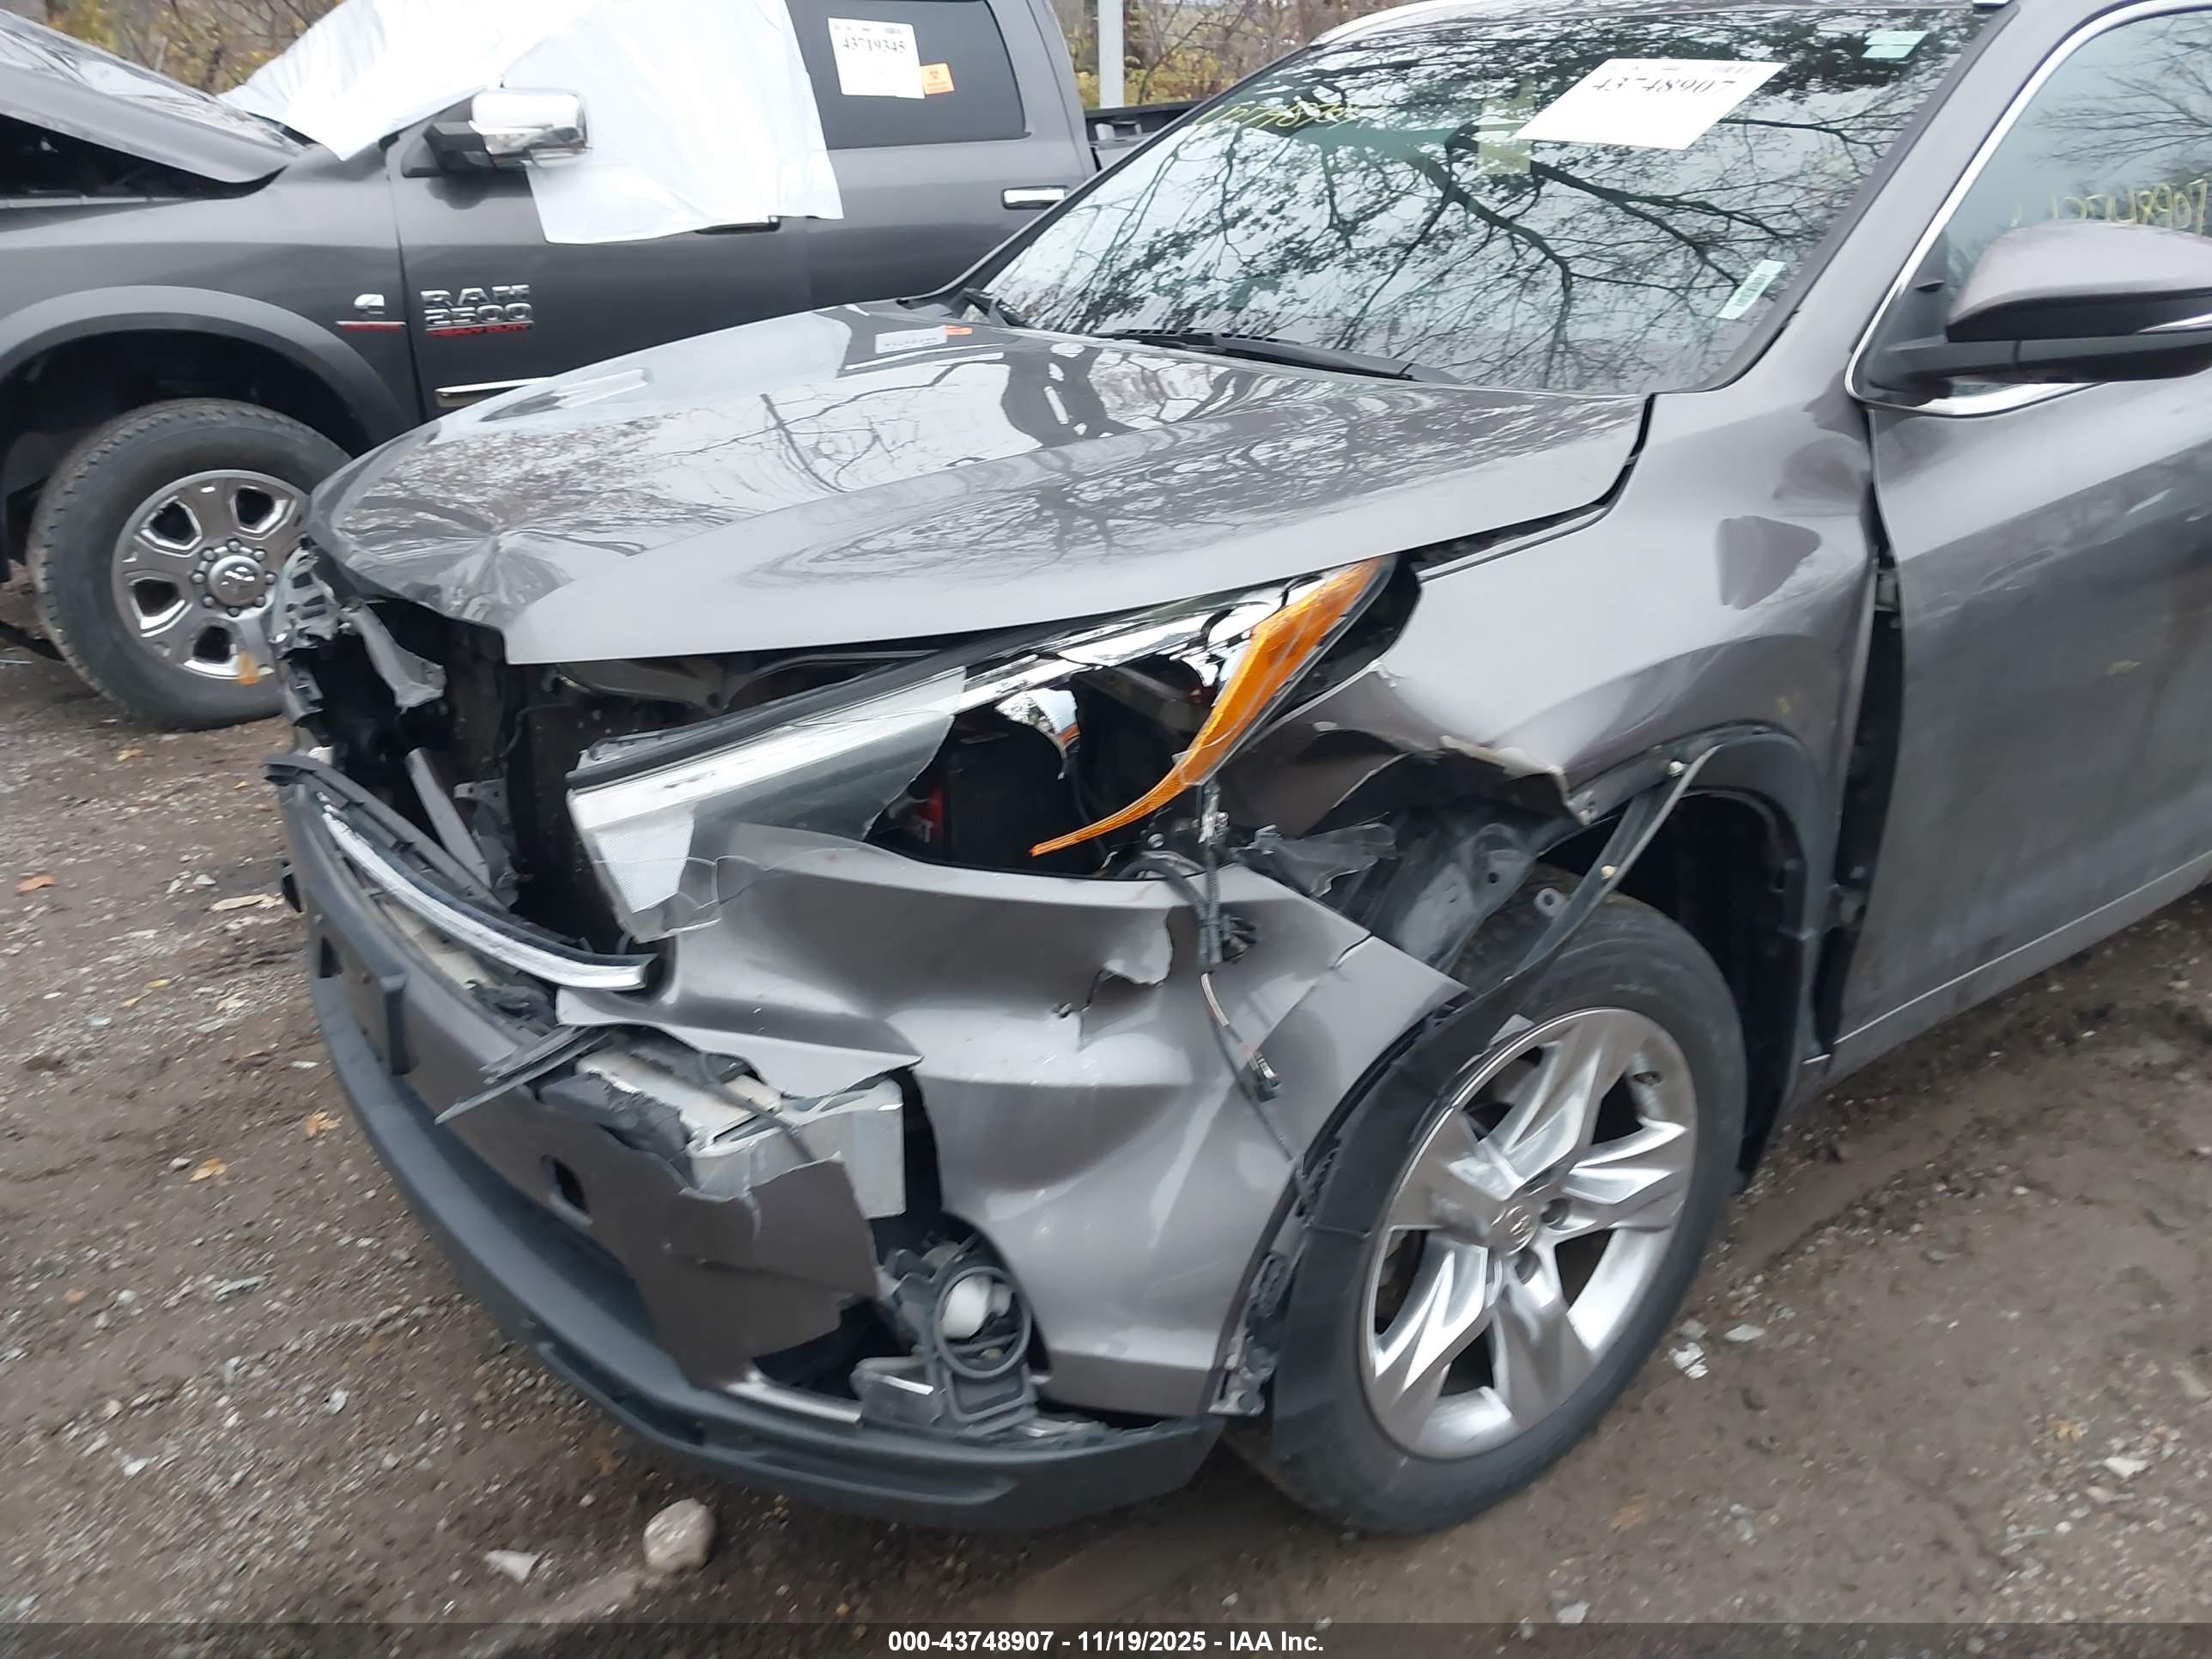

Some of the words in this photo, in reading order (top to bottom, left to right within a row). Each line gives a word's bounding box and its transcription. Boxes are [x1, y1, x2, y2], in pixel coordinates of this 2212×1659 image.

[842, 36, 907, 53] 43719345
[1591, 76, 1738, 94] 43748907
[420, 283, 530, 307] RAM
[423, 302, 533, 325] 2500
